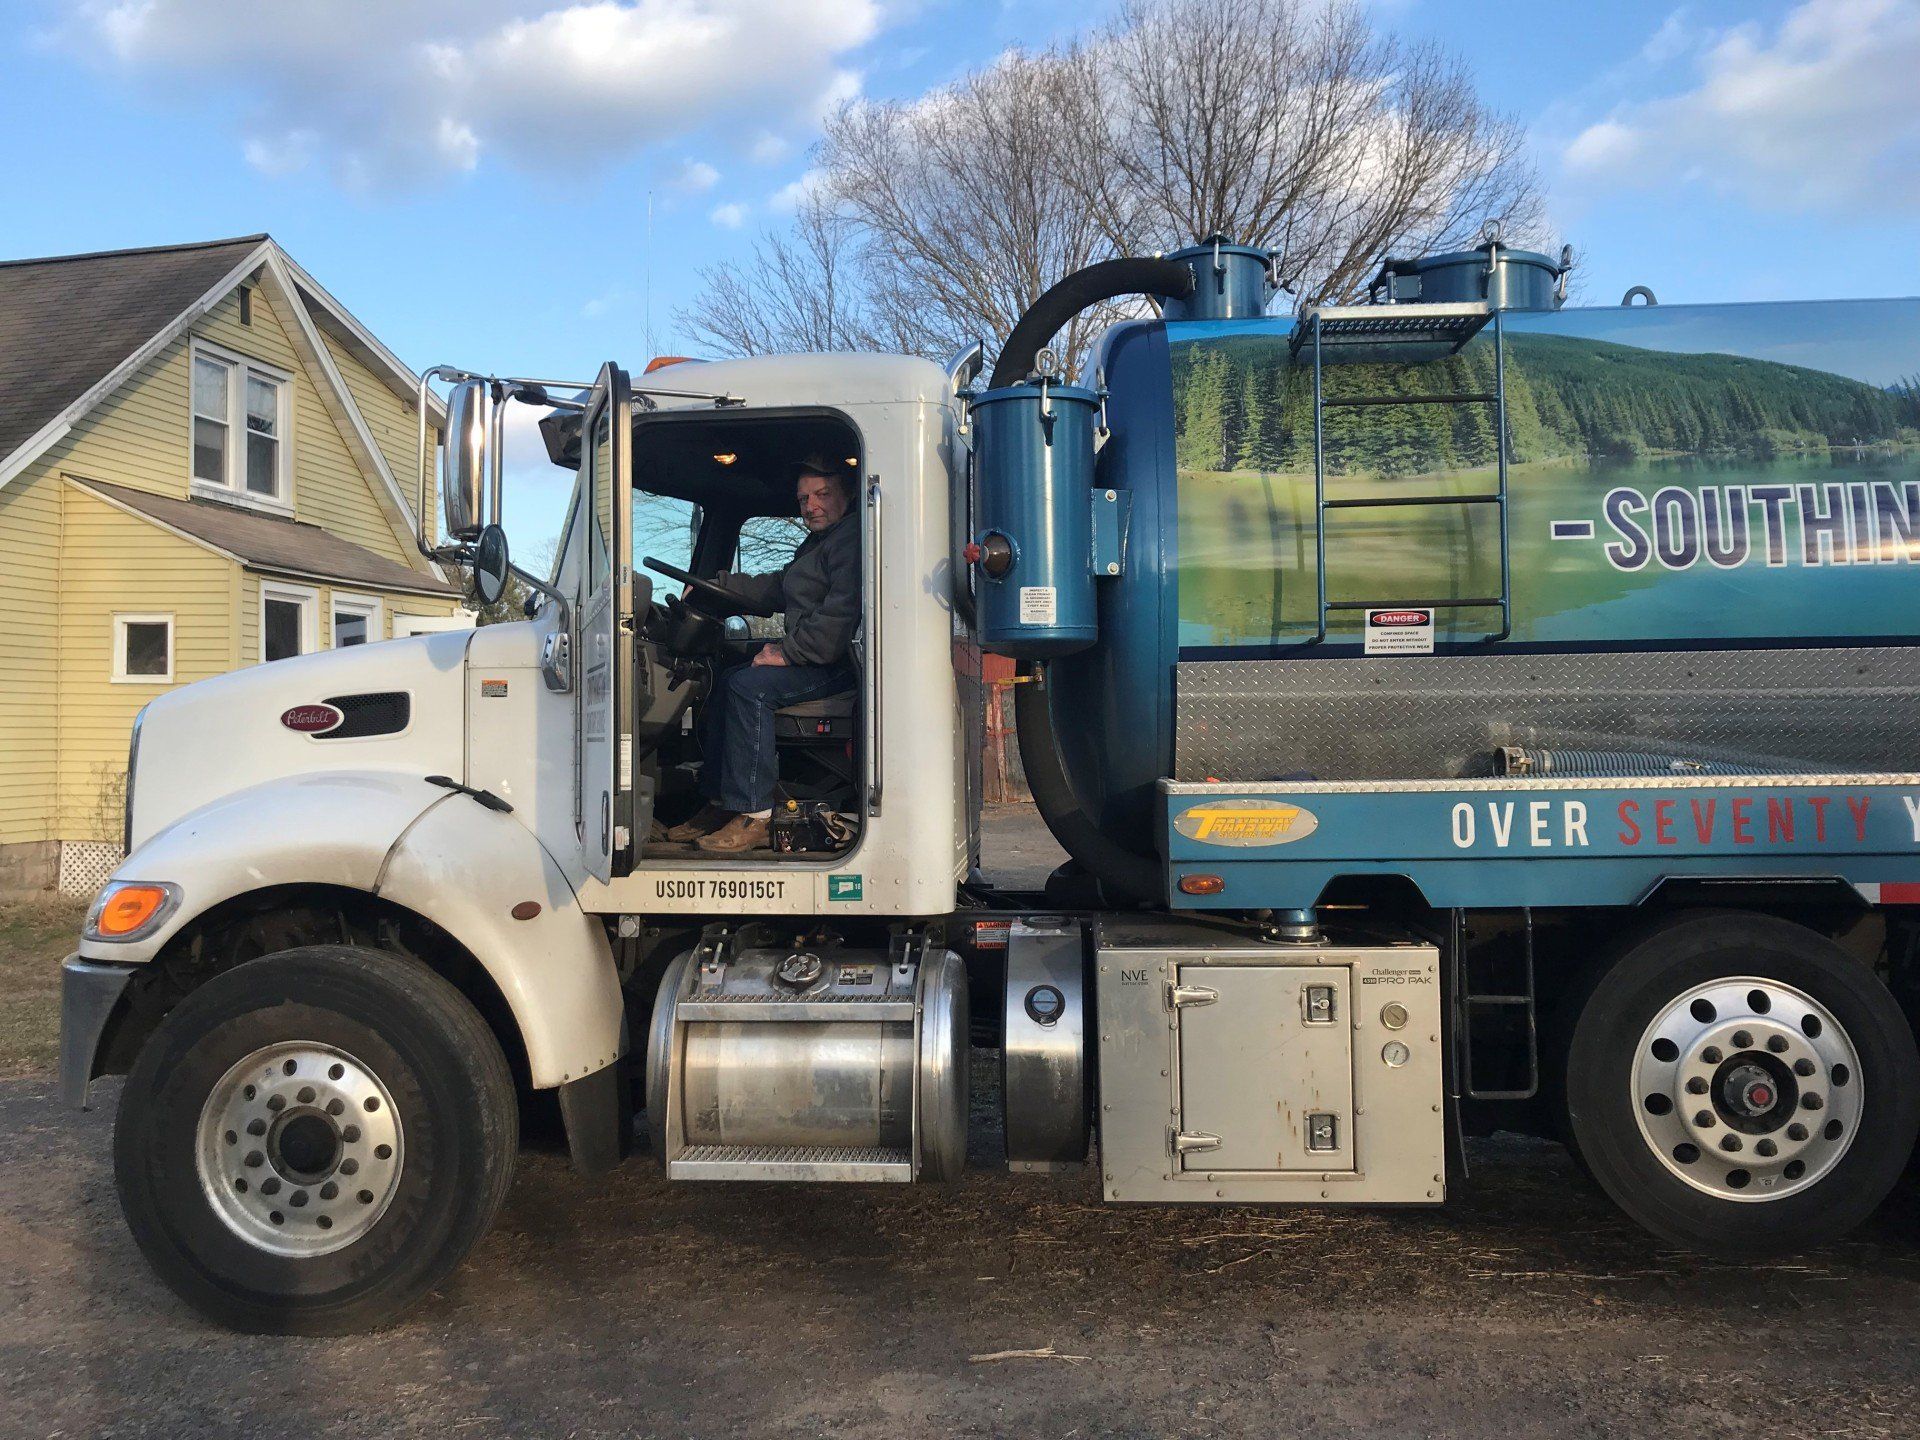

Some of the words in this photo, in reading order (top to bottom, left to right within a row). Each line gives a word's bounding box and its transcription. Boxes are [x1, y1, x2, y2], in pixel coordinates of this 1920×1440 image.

[1380, 614, 1420, 623] DANGER
[287, 710, 333, 726] Peterbilt
[1452, 801, 1589, 849] OVER
[1617, 796, 1872, 846] SEVENTY
[656, 880, 706, 898] USDOT
[709, 880, 785, 899] 769015CT
[1121, 969, 1149, 981] NVE
[1372, 968, 1407, 976] Challenger
